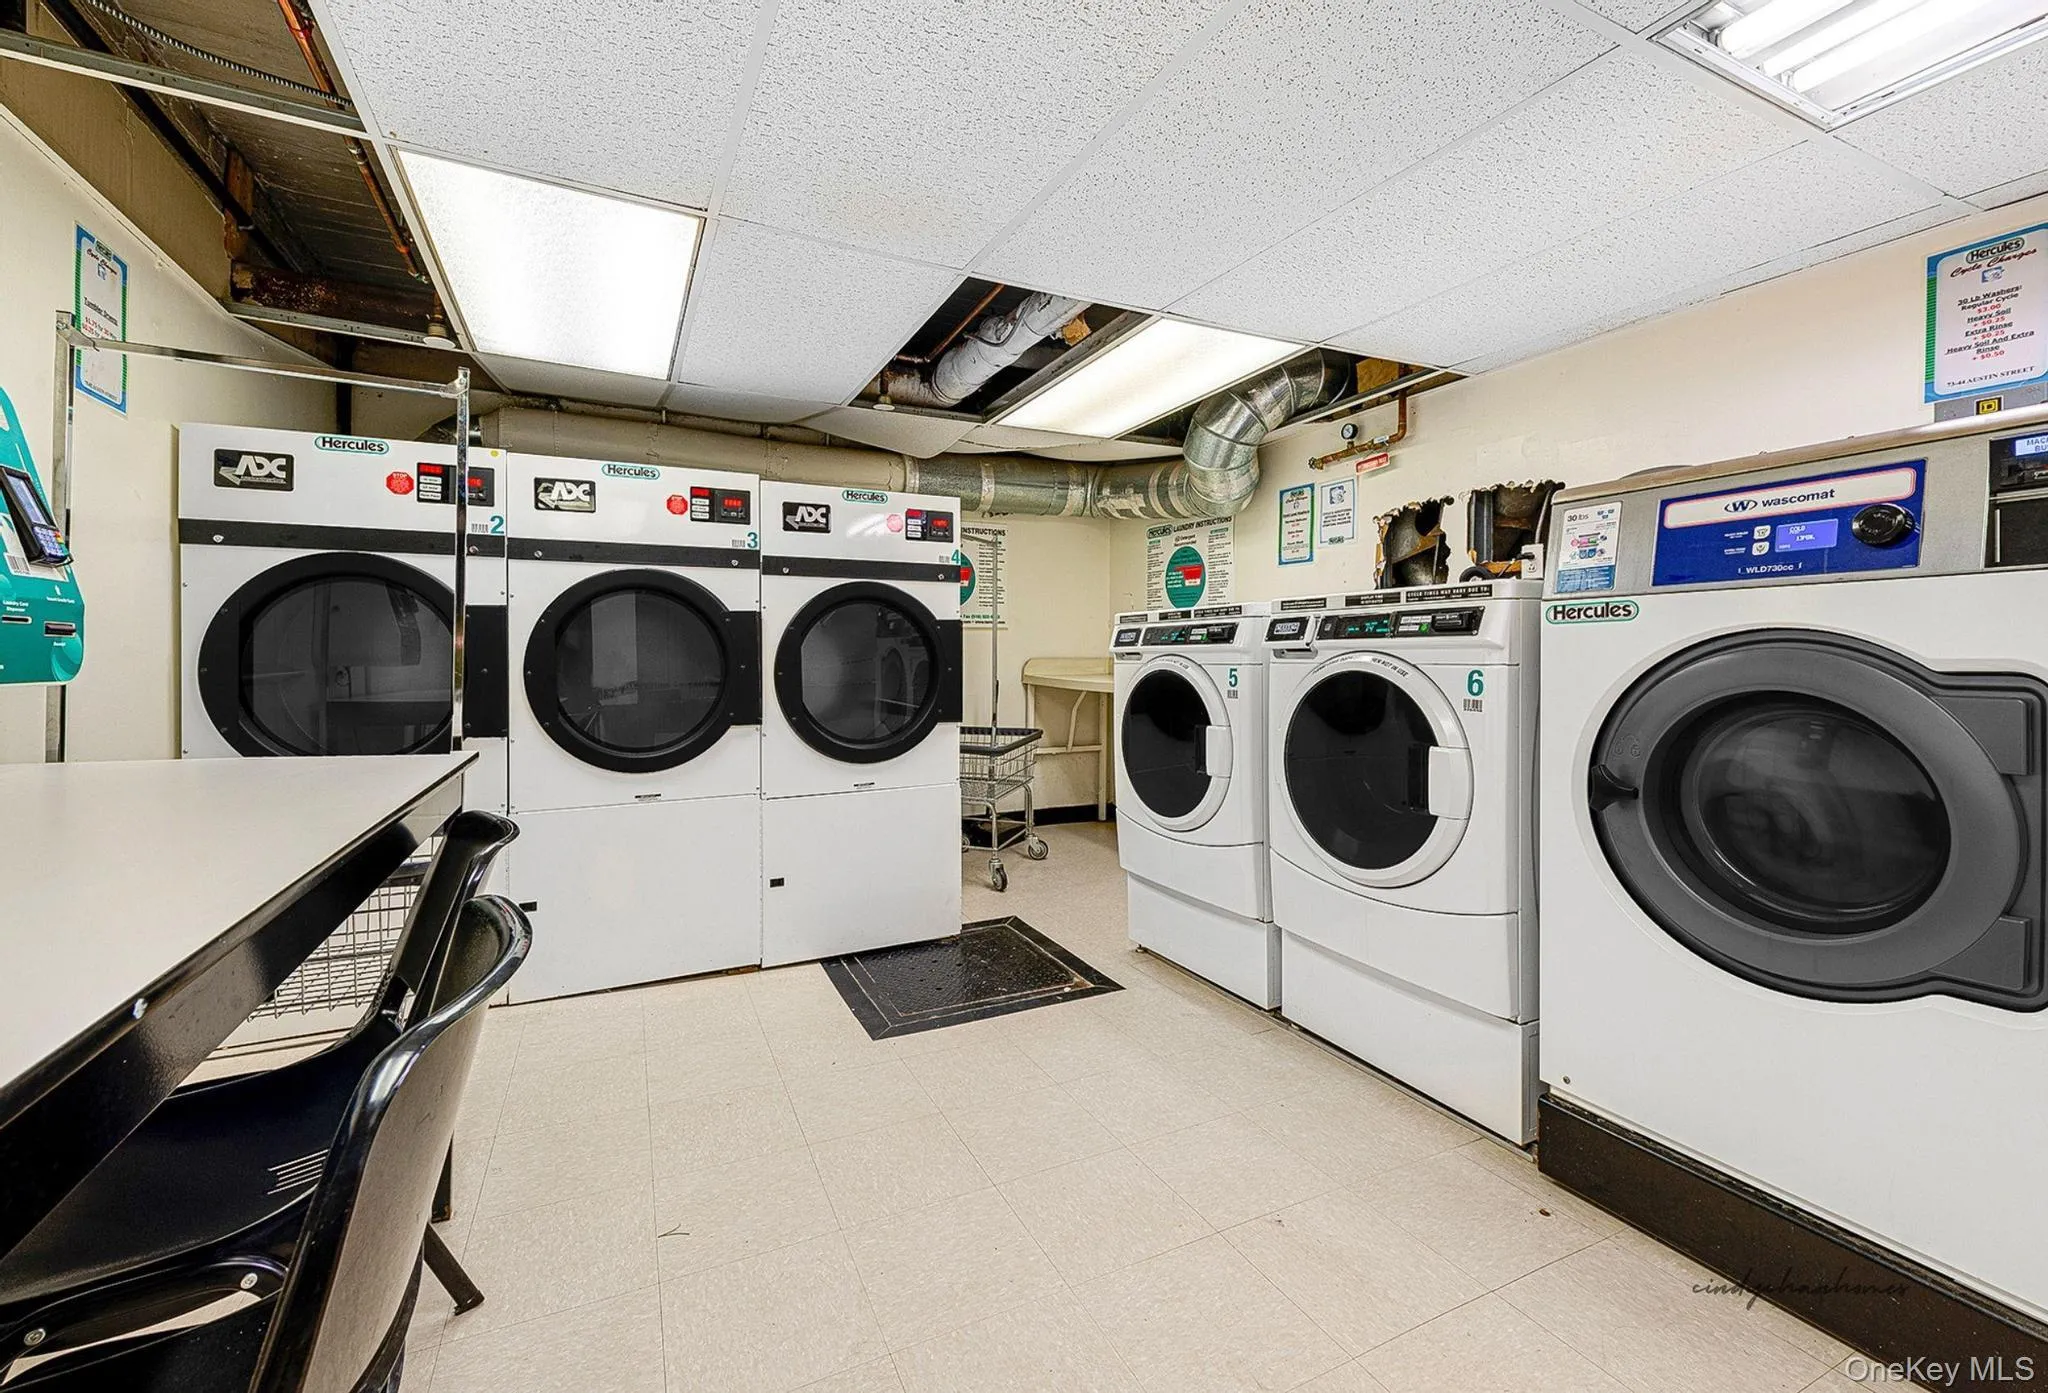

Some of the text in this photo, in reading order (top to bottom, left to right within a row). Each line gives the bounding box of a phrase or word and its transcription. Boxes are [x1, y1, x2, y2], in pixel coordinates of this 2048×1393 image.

[1970, 239, 2020, 261] Hercules
[1950, 249, 2037, 277] Cycle Charges
[1961, 292, 2019, 311] Regular Cycle
[1967, 307, 2011, 324] Heavy Soil
[1965, 321, 2013, 338] Extra Rinse
[1946, 331, 2034, 355] Heavy Soil And Extra
[1976, 344, 2000, 354] Rinse
[1967, 373, 1998, 384] AUSTIN
[2000, 366, 2035, 377] STREET
[322, 437, 385, 452] Hercules
[2026, 437, 2048, 446] MAC
[235, 454, 287, 479] ADC
[607, 463, 656, 478] Hercules
[550, 480, 591, 502] ADC
[846, 490, 886, 503] Hercules
[1762, 488, 1836, 508] wascomat
[795, 505, 827, 523] ADC
[1567, 513, 1578, 522] 30
[490, 515, 505, 534] 2
[747, 532, 758, 549] 3
[951, 549, 960, 564] 4
[1745, 564, 1794, 574] WLD730cc
[1553, 602, 1632, 620] Hercules
[1228, 668, 1238, 688] 5
[1467, 669, 1484, 697] 6
